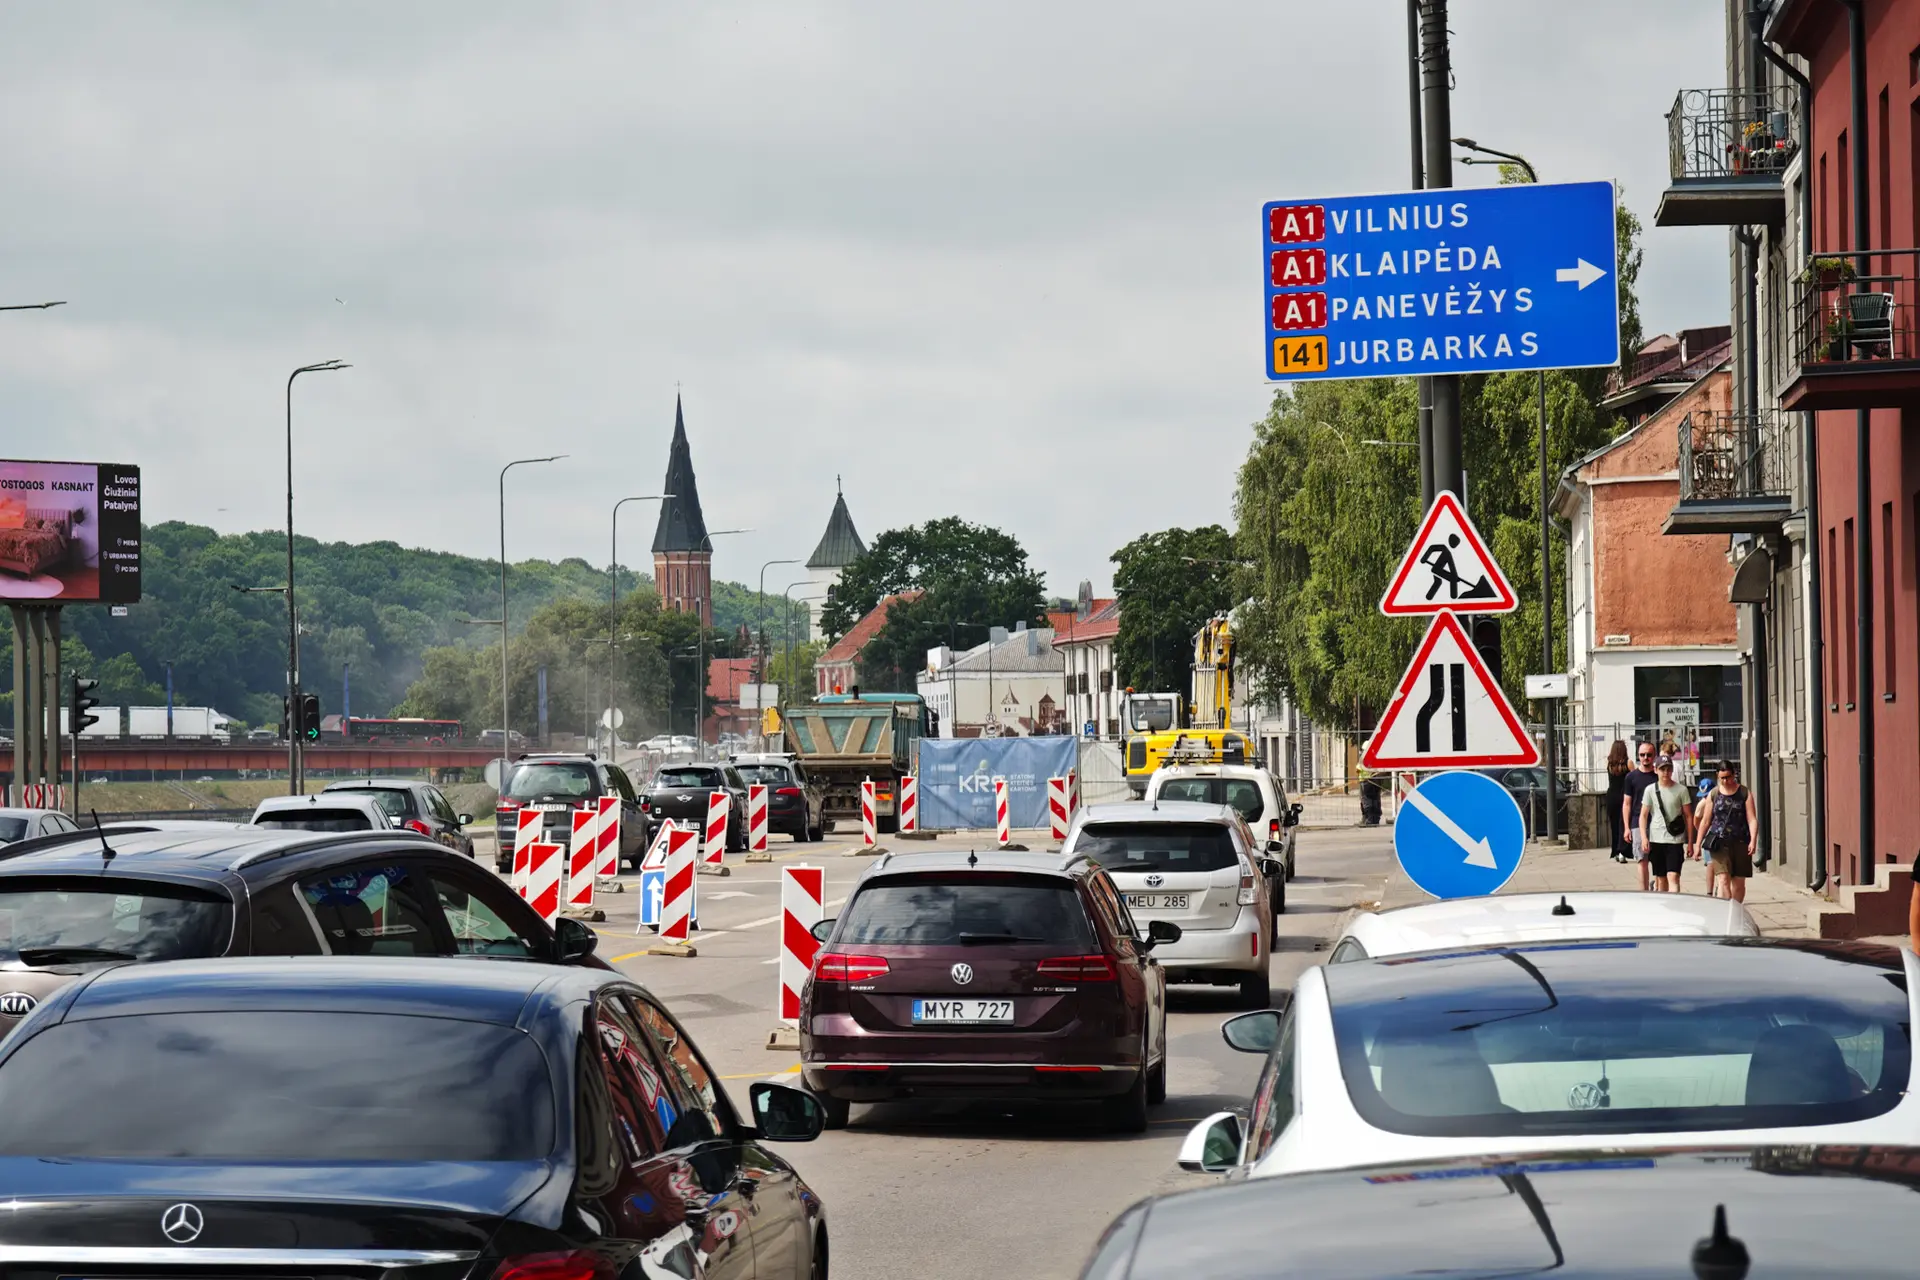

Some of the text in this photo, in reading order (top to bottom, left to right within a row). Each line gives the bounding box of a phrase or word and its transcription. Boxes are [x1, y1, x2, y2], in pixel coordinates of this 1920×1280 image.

[1282, 203, 1469, 237] A1 VILNIUS
[1283, 241, 1502, 280] A1 KLAIPĖDA
[1284, 282, 1534, 324] A1 PANEVĖŽYS
[1279, 331, 1539, 367] 141 JURBARKAS
[51, 482, 94, 492] KASNAKT
[115, 475, 138, 484] Lovos
[104, 485, 138, 498] Čiužiniai
[104, 500, 138, 512] Patalynė
[1128, 896, 1186, 907] MEU 285
[0, 997, 30, 1012] KIA
[924, 1001, 1011, 1019] MYR 727
